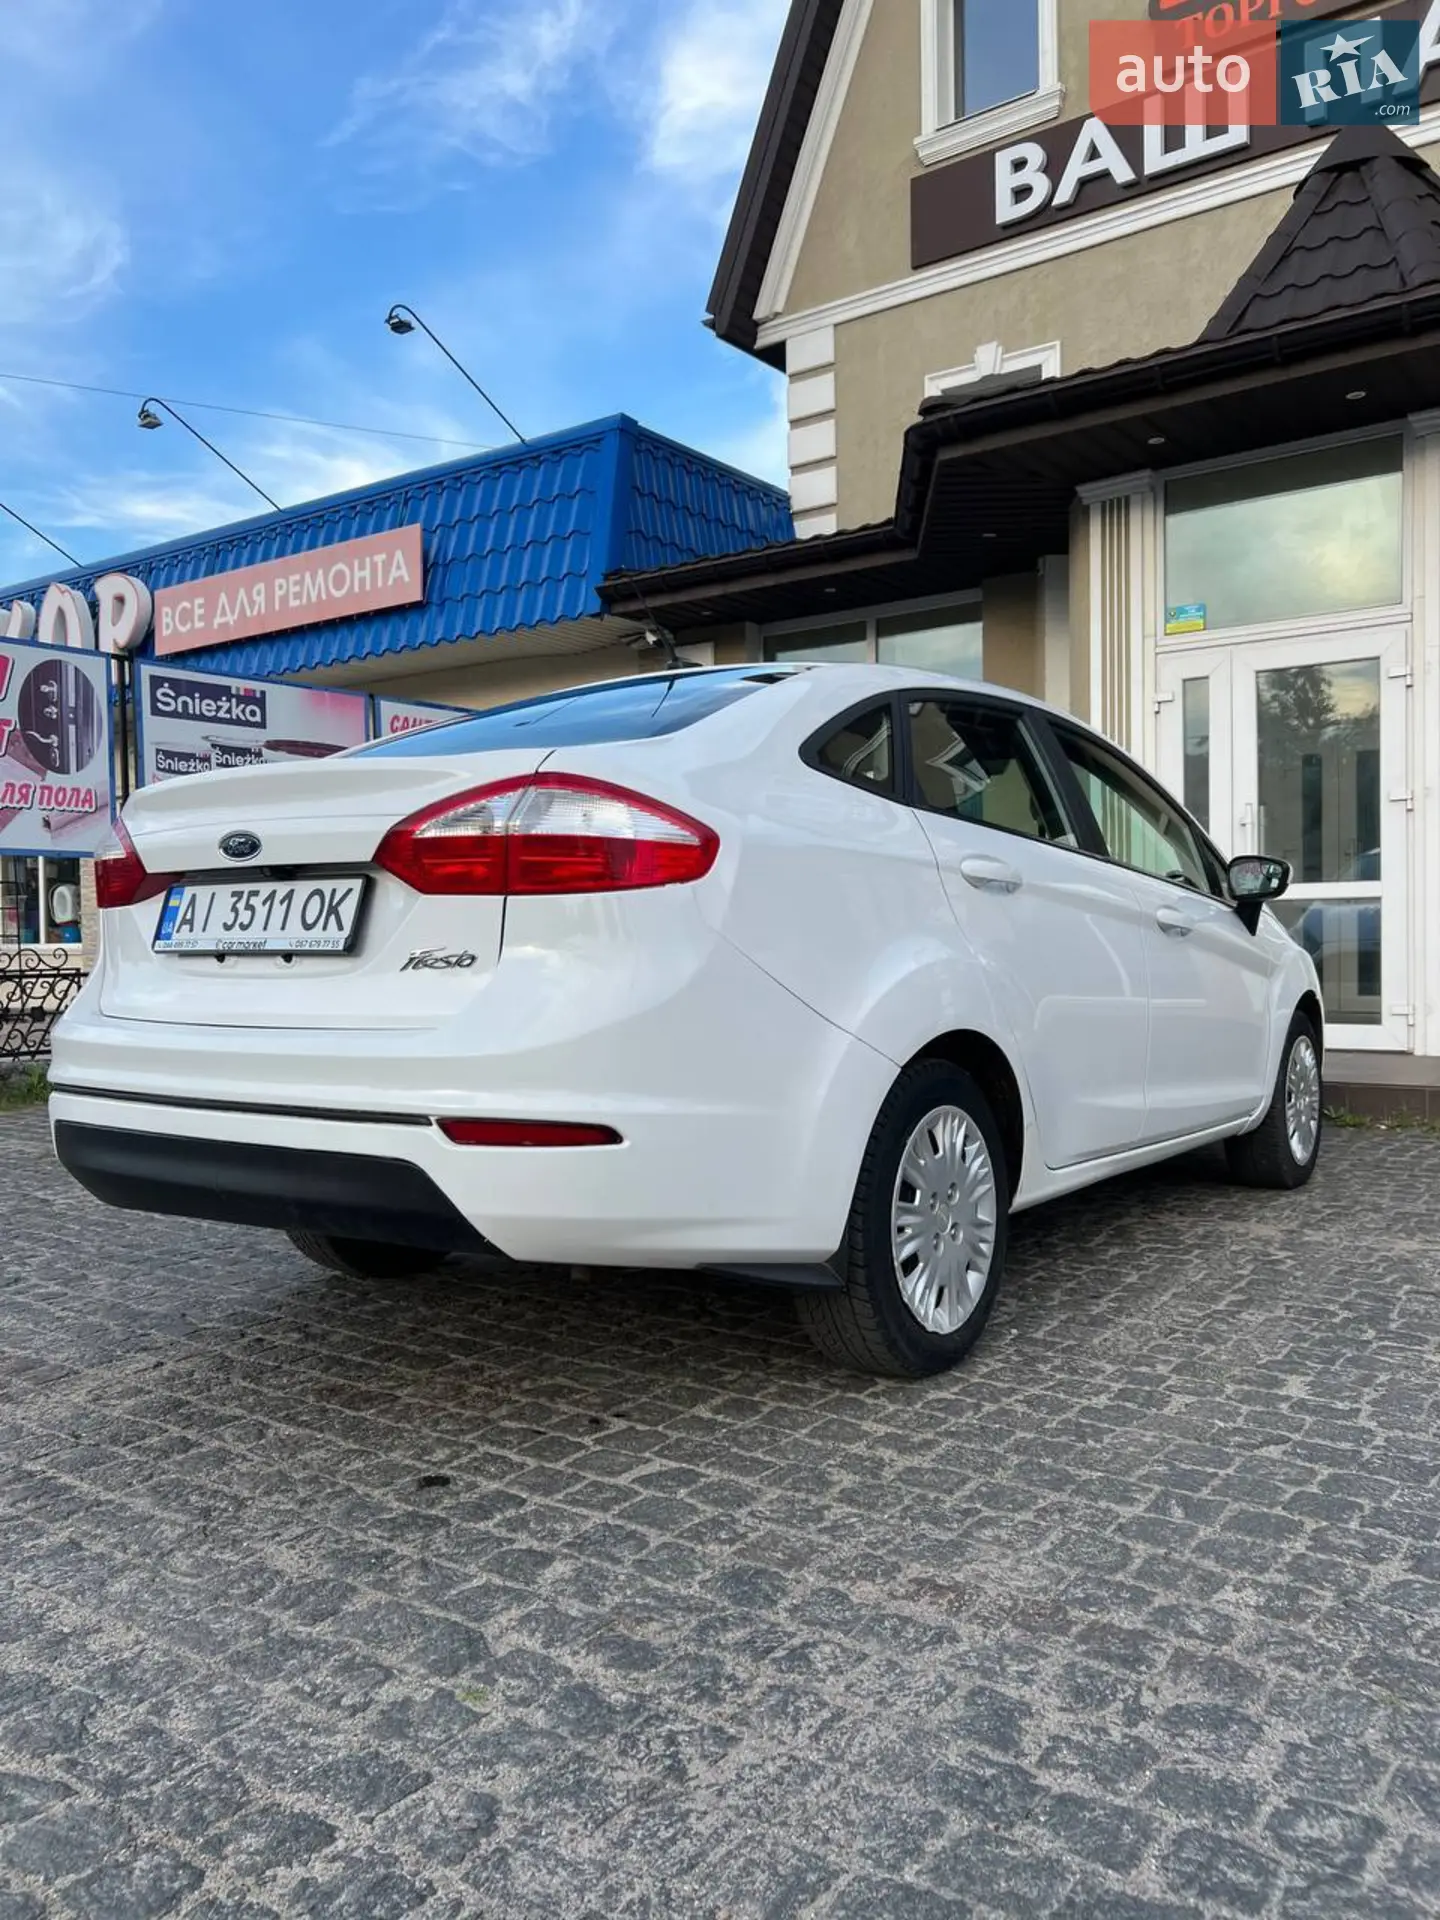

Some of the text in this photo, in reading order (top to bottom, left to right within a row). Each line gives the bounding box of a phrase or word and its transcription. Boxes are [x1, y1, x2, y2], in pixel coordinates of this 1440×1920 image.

[994, 66, 1252, 227] ВАШ
[162, 549, 411, 637] ВСЕ ДЛЯ РЕМОНТА
[155, 682, 262, 723] Śnieżka
[38, 784, 96, 809] ПОЛА
[175, 887, 354, 934] AI 3511 OK
